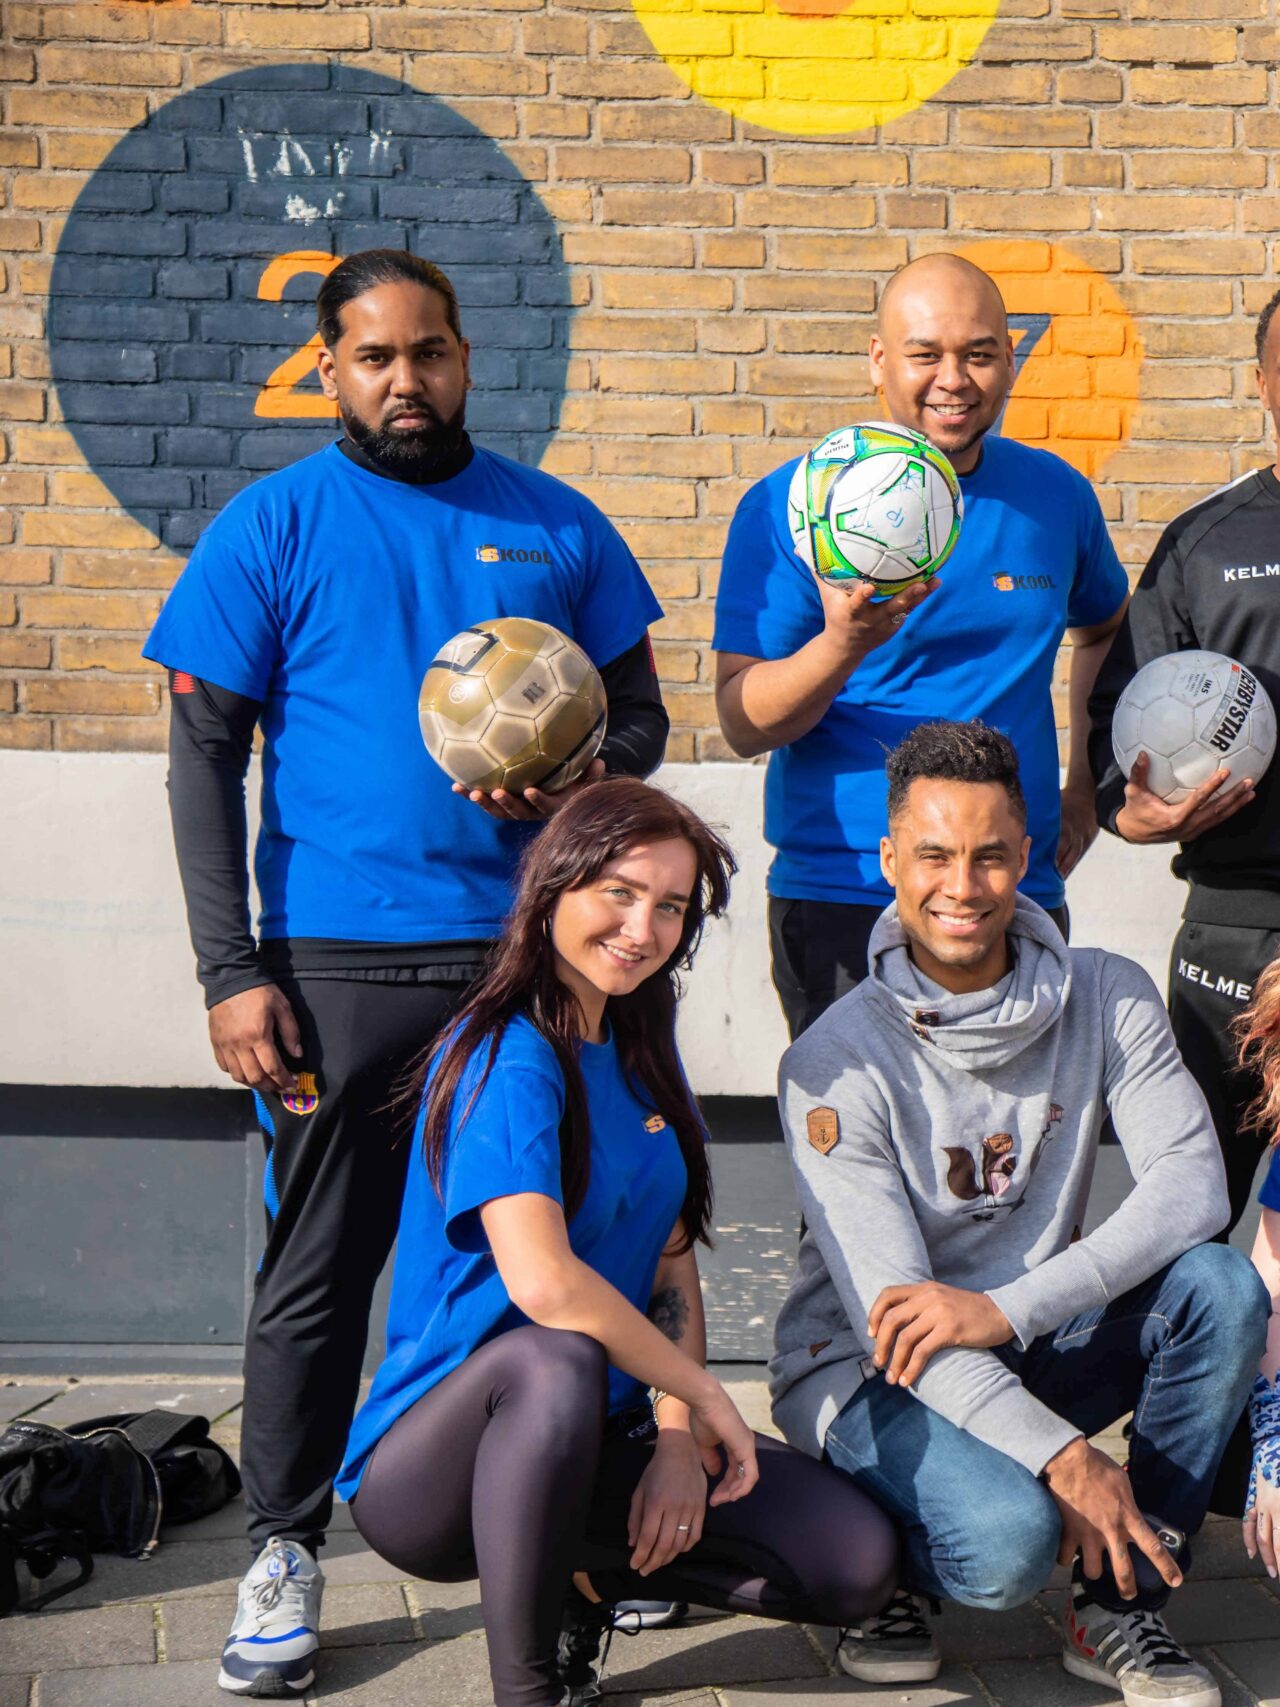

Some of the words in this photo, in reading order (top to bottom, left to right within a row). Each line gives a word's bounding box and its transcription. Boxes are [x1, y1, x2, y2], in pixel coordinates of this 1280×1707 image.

[254, 250, 344, 418] 2
[984, 313, 1052, 437] 7
[479, 547, 552, 564] SKOOL
[996, 574, 1057, 591] SKOOL
[1201, 679, 1213, 694] IMS
[1209, 668, 1257, 752] DERBYSTAR
[1178, 958, 1252, 1001] KELME
